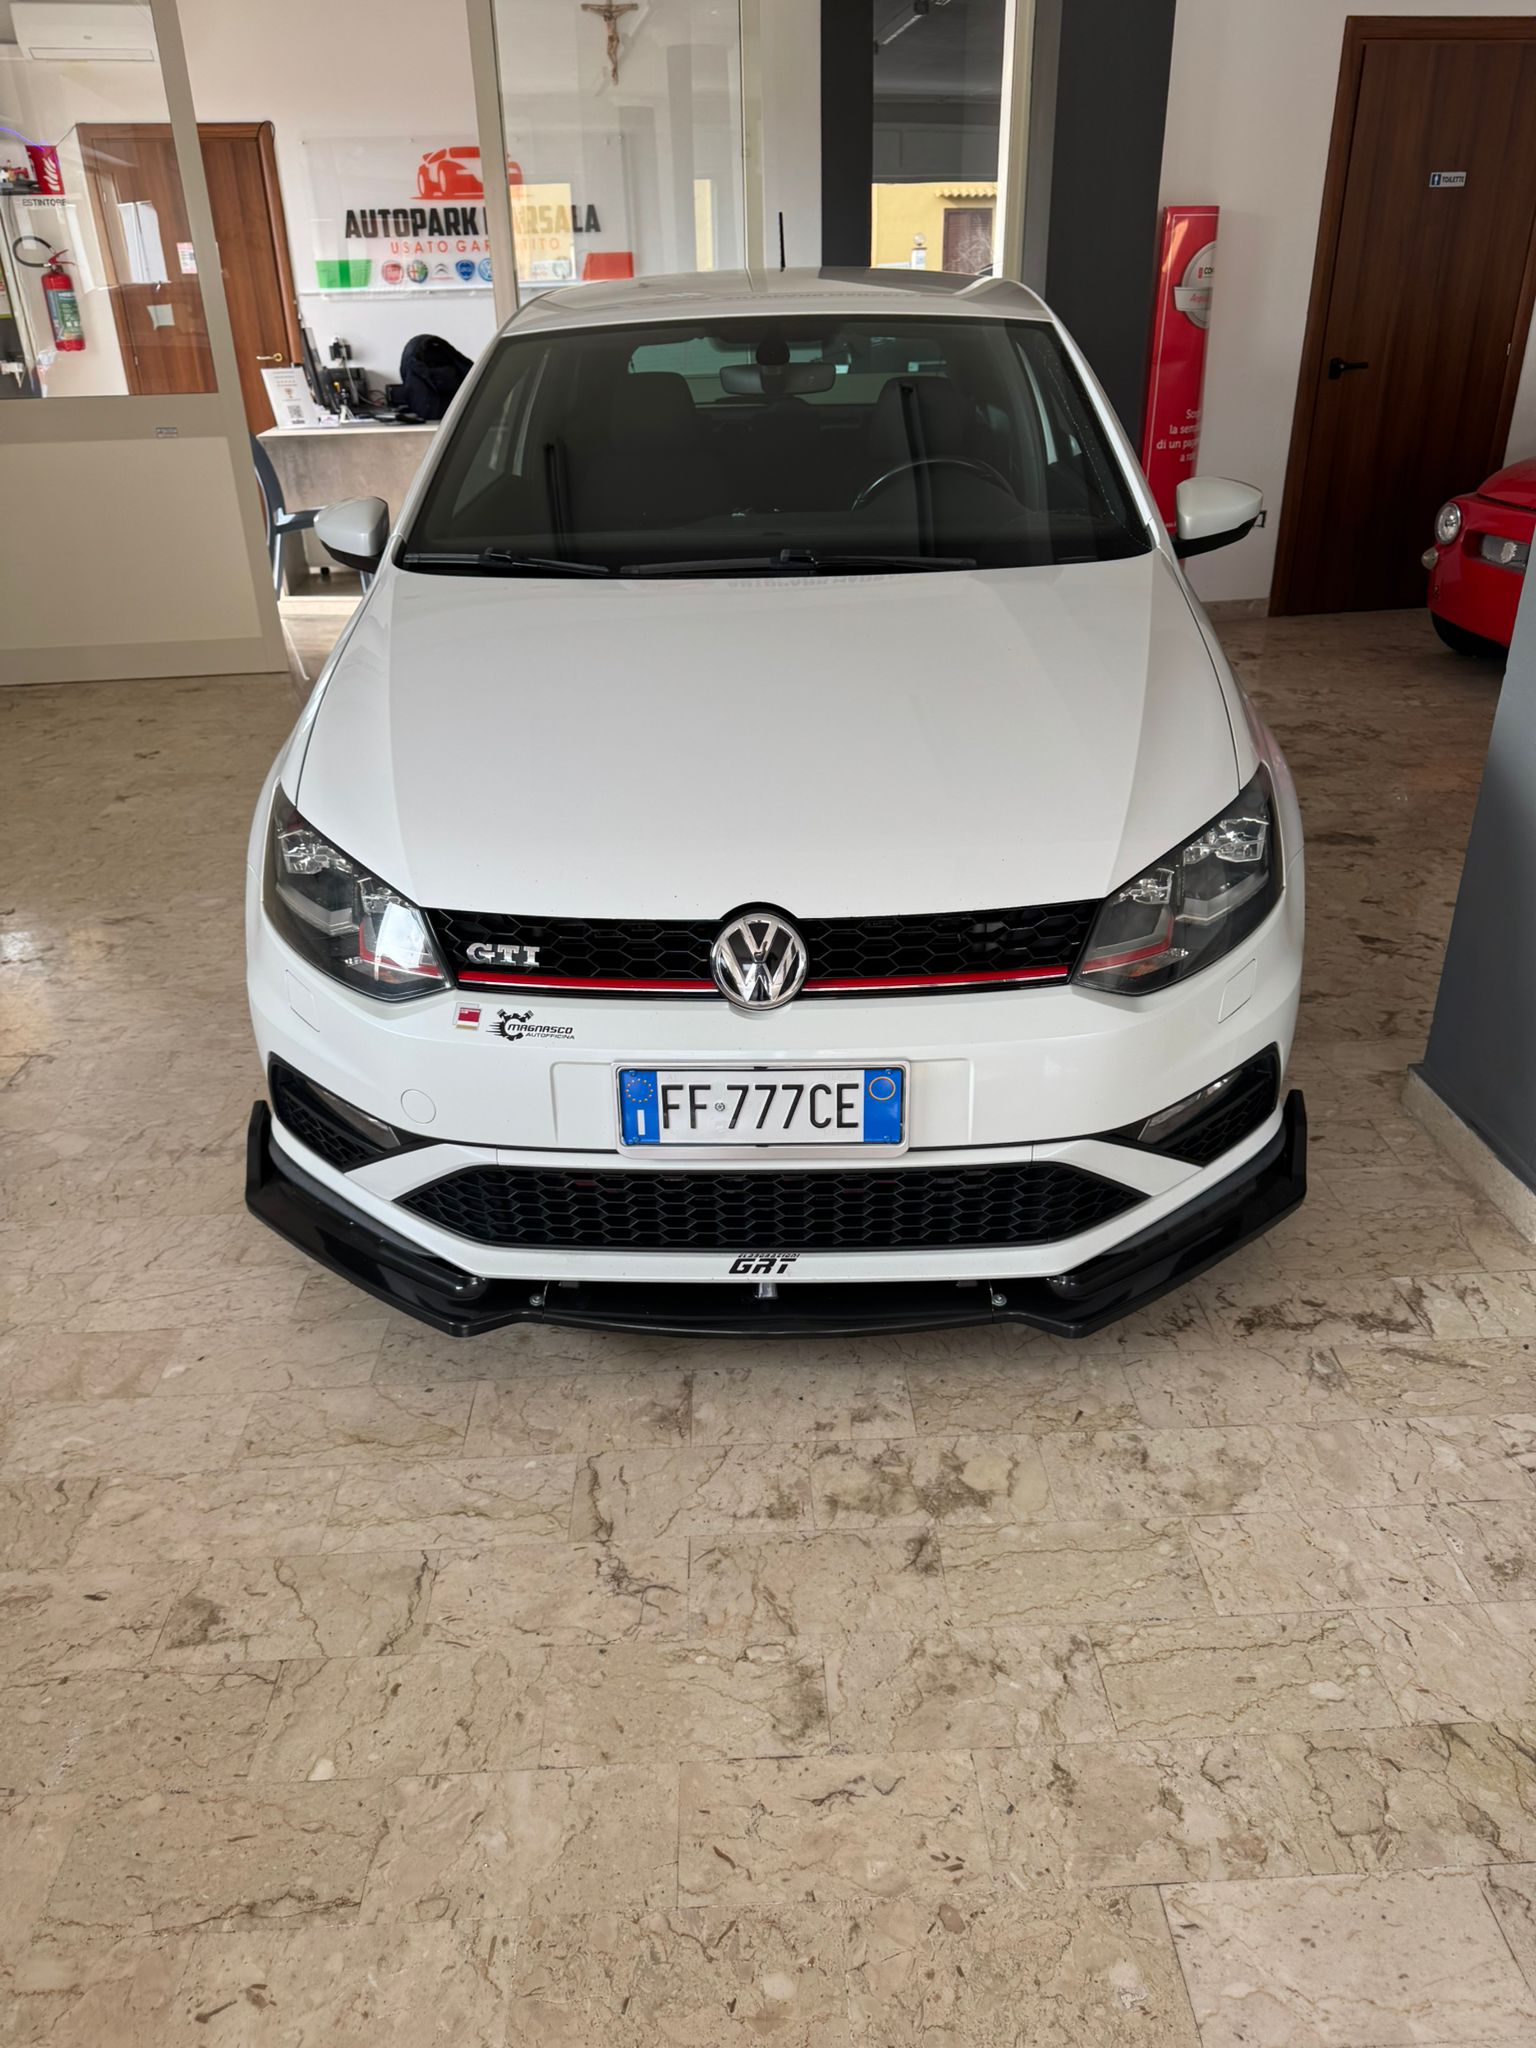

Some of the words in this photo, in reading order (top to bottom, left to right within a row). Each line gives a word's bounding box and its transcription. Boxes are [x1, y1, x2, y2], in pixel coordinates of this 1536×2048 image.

[345, 207, 479, 238] AUTOPARK
[390, 240, 448, 254] USATO
[456, 237, 560, 253] GARTITO
[1169, 425, 1178, 434] la
[1156, 439, 1167, 450] di
[1168, 441, 1181, 449] un
[466, 942, 540, 968] GTI
[507, 1023, 573, 1035] MAGNASCO
[525, 1032, 575, 1040] AUTOFFICINA
[728, 1258, 797, 1274] GRT
